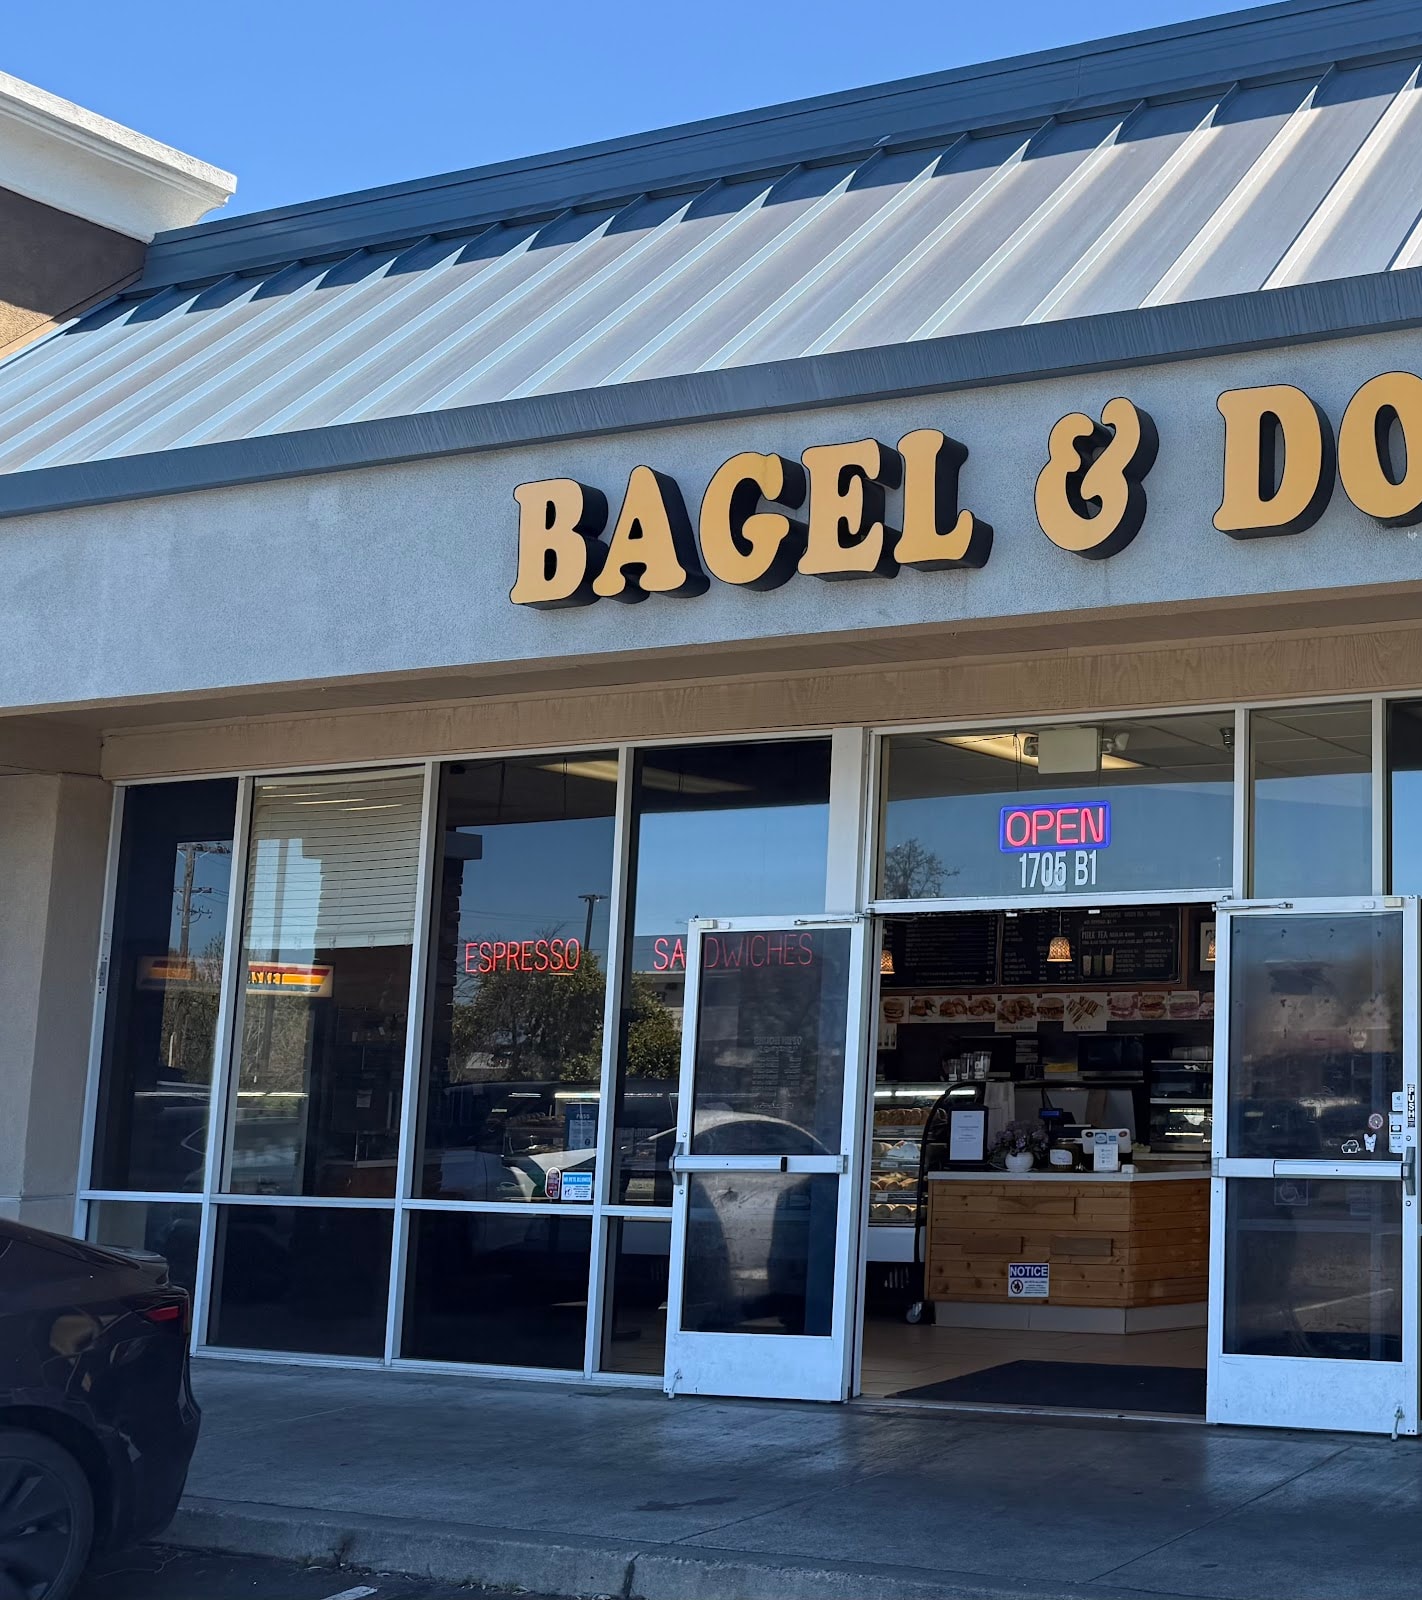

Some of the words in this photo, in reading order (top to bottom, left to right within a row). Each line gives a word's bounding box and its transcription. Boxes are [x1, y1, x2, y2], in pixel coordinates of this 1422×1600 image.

[509, 428, 982, 606] BAGEL
[1034, 397, 1150, 556] &
[1006, 806, 1104, 847] OPEN
[1019, 851, 1067, 889] 1705
[1074, 849, 1097, 886] B1
[465, 938, 581, 973] ESPRESSO
[653, 933, 813, 971] SADWICHES
[1010, 1266, 1048, 1277] NOTICE
